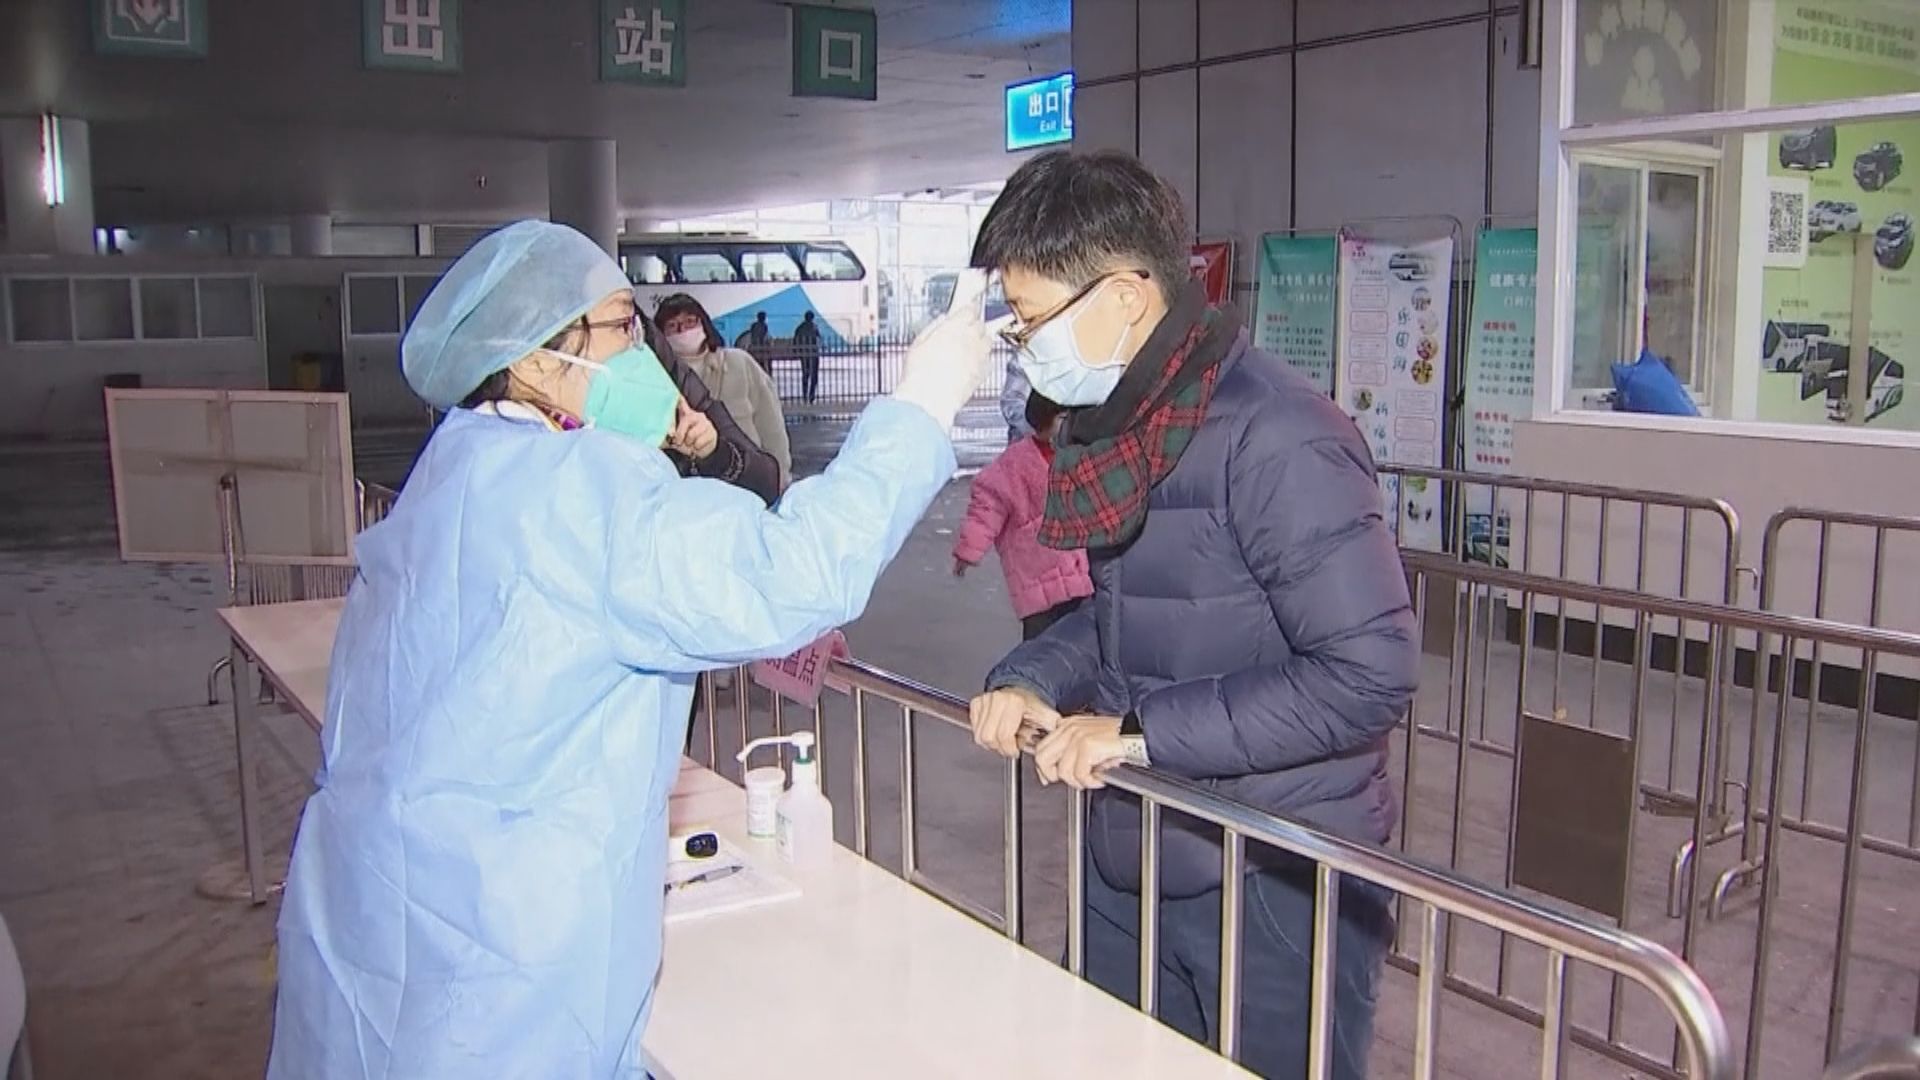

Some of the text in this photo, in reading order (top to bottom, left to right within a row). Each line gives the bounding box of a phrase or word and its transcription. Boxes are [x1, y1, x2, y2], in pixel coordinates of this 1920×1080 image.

[383, 0, 862, 82] 出 站 口
[1028, 91, 1059, 118] 出口
[1040, 119, 1057, 133] Exit
